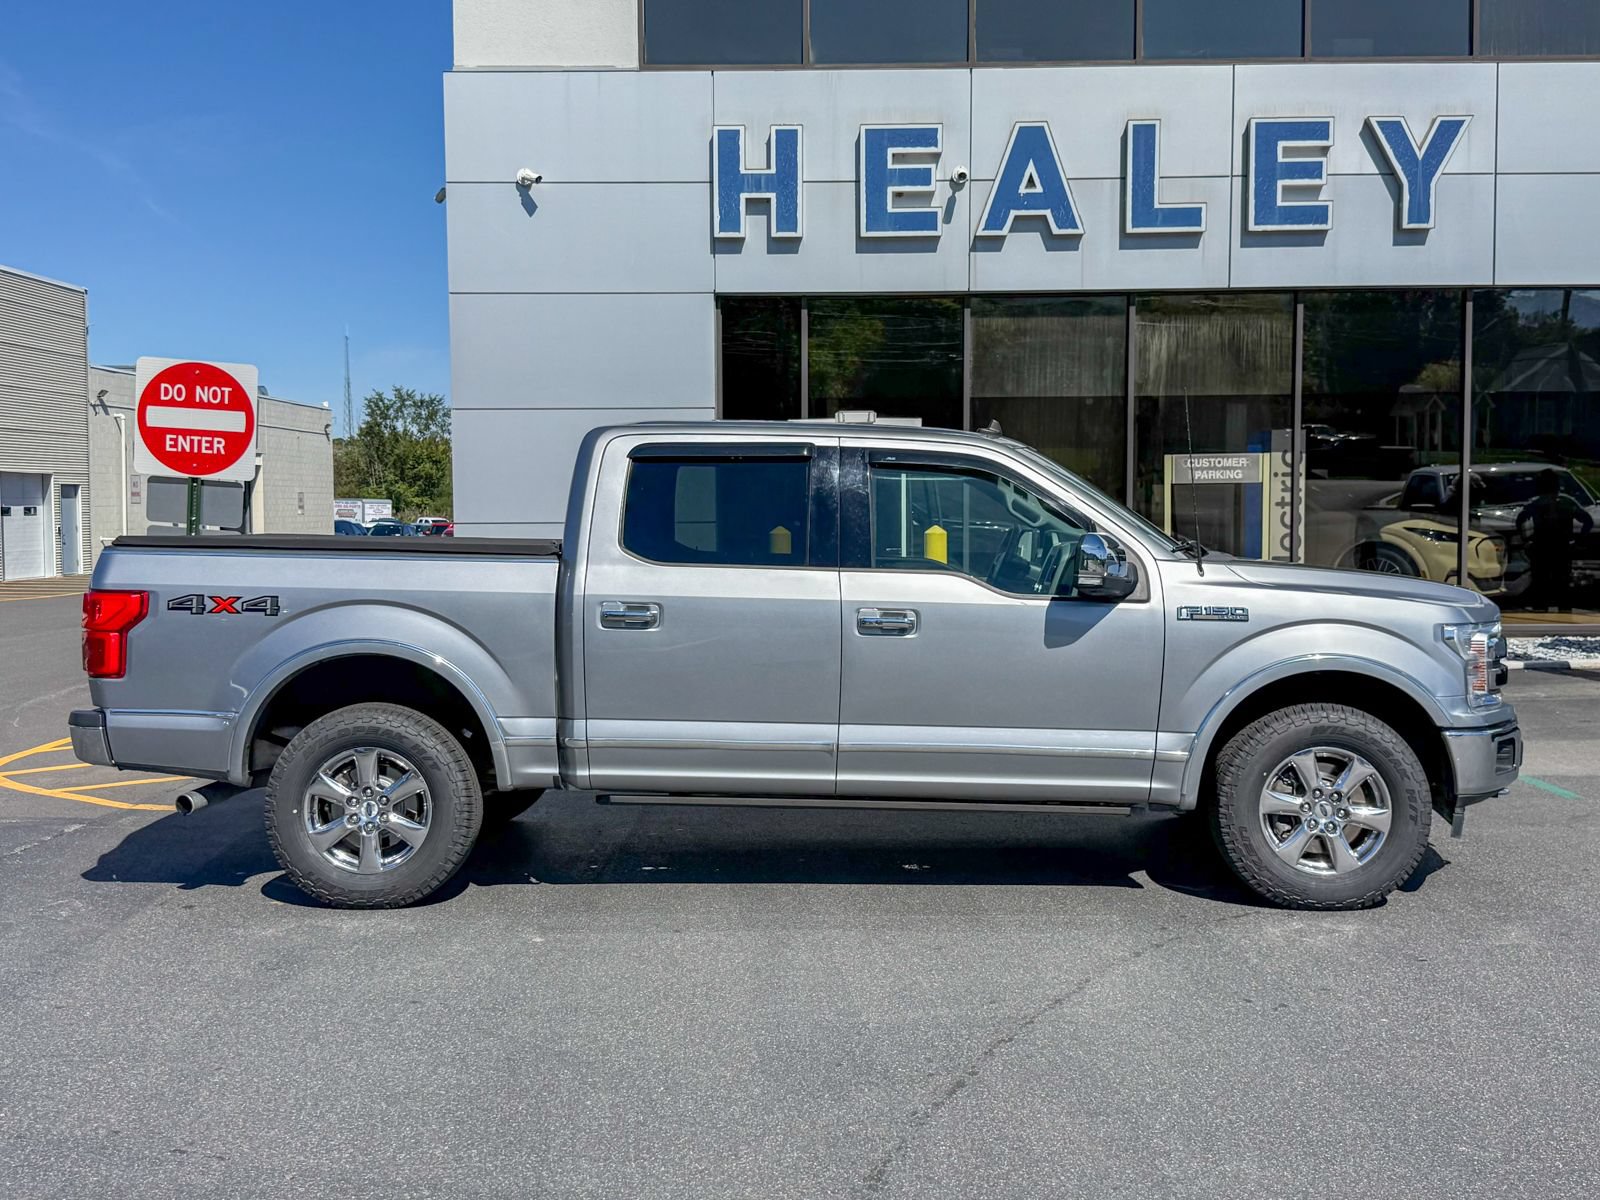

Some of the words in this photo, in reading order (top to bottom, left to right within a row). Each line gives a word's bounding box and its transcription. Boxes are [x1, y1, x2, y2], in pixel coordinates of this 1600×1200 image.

[712, 115, 1473, 240] HEALEY
[160, 383, 187, 402] DO
[195, 385, 233, 405] NOT
[165, 434, 226, 455] ENTER
[1186, 457, 1248, 468] CUSTOMER
[1194, 469, 1243, 480] PARKING
[303, 725, 411, 761] WILDPEAK
[1310, 725, 1411, 781] WILDPEAK
